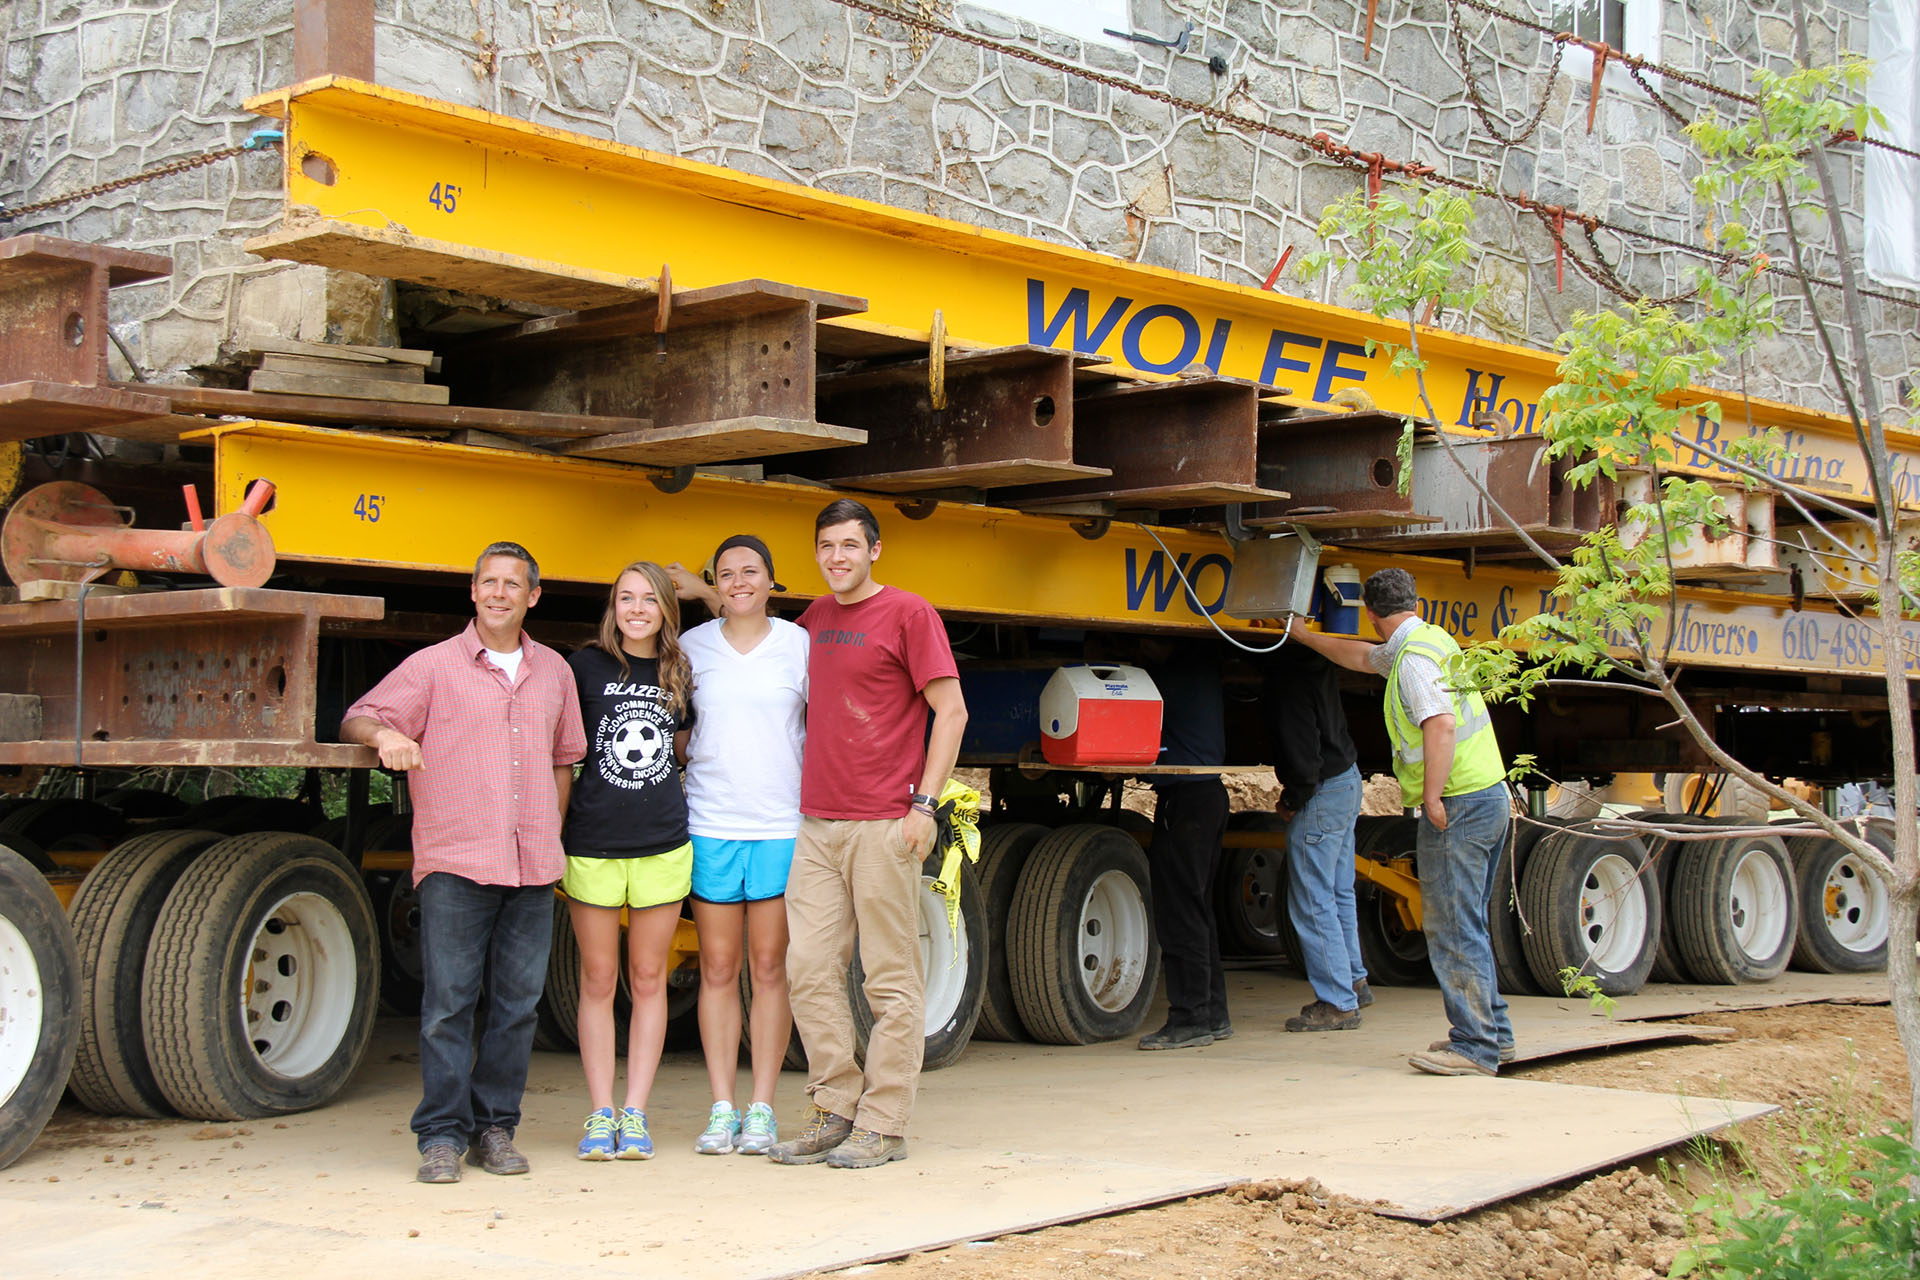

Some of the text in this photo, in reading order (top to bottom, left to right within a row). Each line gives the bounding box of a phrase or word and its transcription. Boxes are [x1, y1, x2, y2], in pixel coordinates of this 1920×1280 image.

[1417, 597, 1479, 638] ouse
[835, 629, 853, 645] DO
[607, 709, 664, 733] CONFIDENCE
[614, 700, 675, 726] COMMITMENT
[595, 714, 611, 753] VICTORY
[649, 760, 673, 786] TRUST
